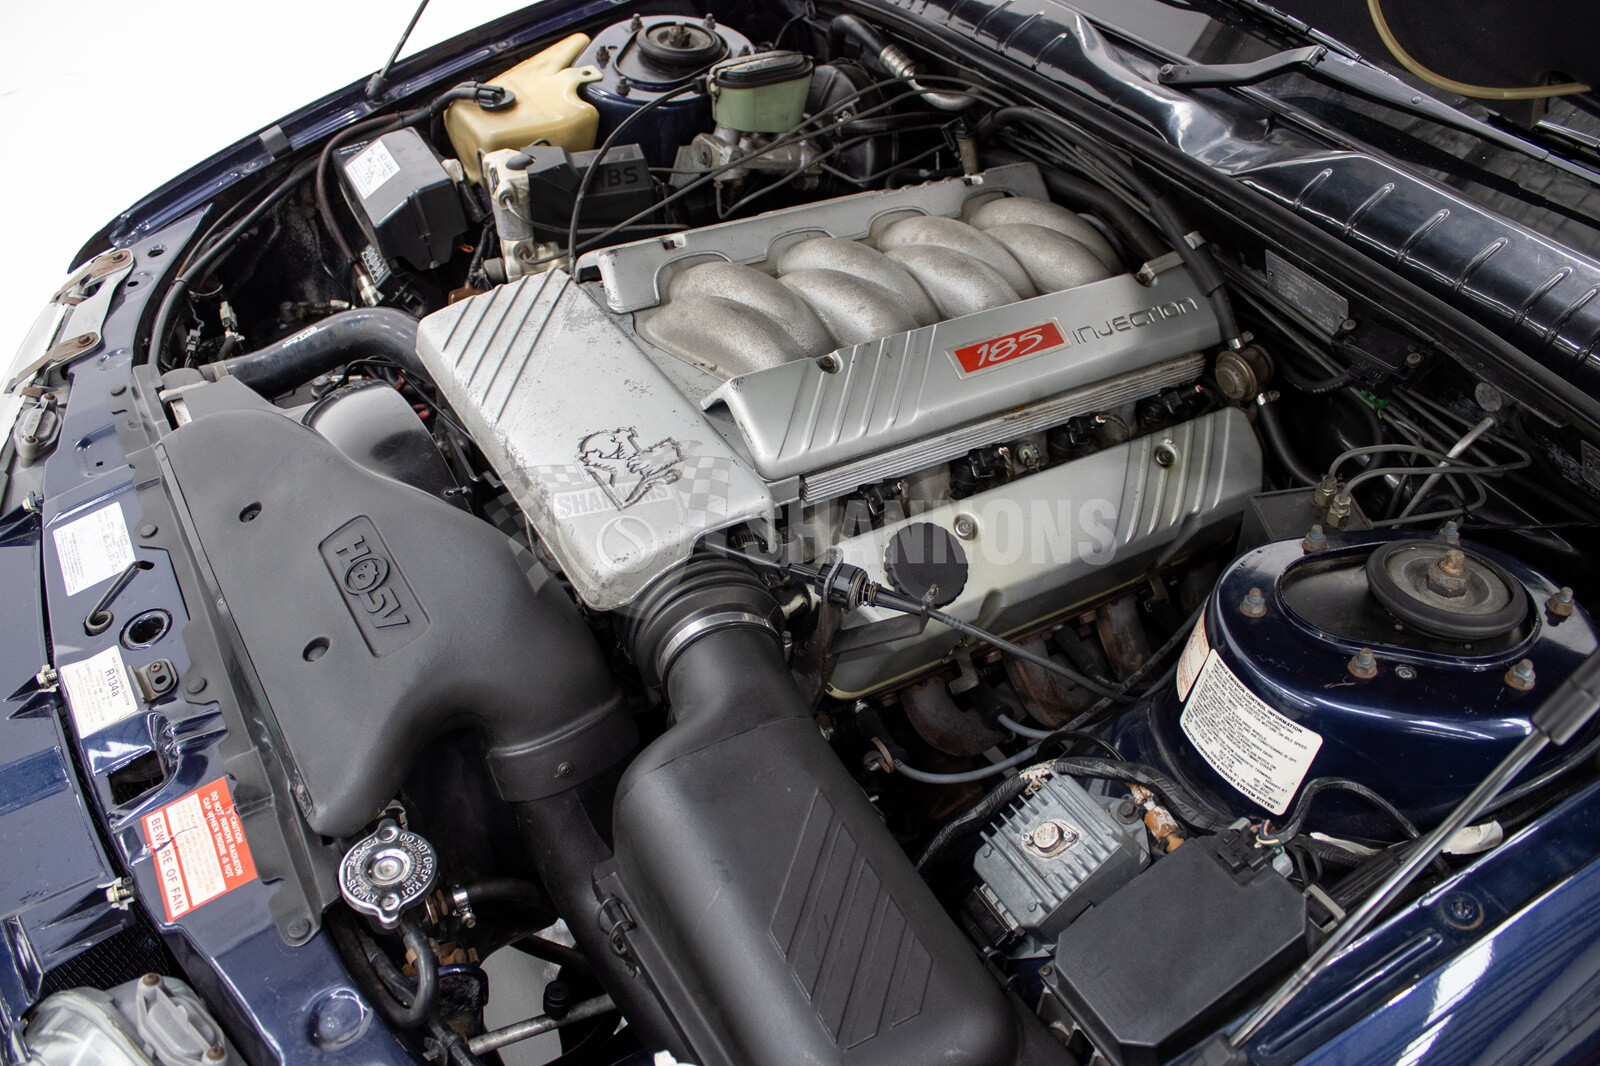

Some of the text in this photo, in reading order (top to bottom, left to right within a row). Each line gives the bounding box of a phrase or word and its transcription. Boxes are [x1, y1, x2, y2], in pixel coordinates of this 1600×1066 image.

[978, 328, 1043, 366] 185
[105, 668, 119, 697] R134a
[1216, 658, 1228, 675] VEHICLE
[1228, 673, 1245, 693] EMISSION
[1245, 691, 1266, 711] CONTROL
[1266, 709, 1303, 733] INFORMATION
[1195, 741, 1217, 765] CONVERTER
[1216, 763, 1236, 783] EXHAUST
[1236, 780, 1255, 798] SYSTEM
[1255, 795, 1275, 809] FITTED
[202, 797, 212, 810] CAP
[206, 812, 220, 833] WHEN
[210, 790, 244, 876] DO NOT REMOVE RADIATOR
[230, 816, 244, 844] CAUTION
[214, 832, 226, 860] ENGINE
[400, 833, 414, 842] DO
[414, 839, 432, 855] NOT
[166, 868, 178, 883] OF
[224, 864, 234, 878] HOT
[421, 857, 432, 882] OPEN
[170, 886, 184, 910] FAN
[402, 880, 422, 899] HOT
